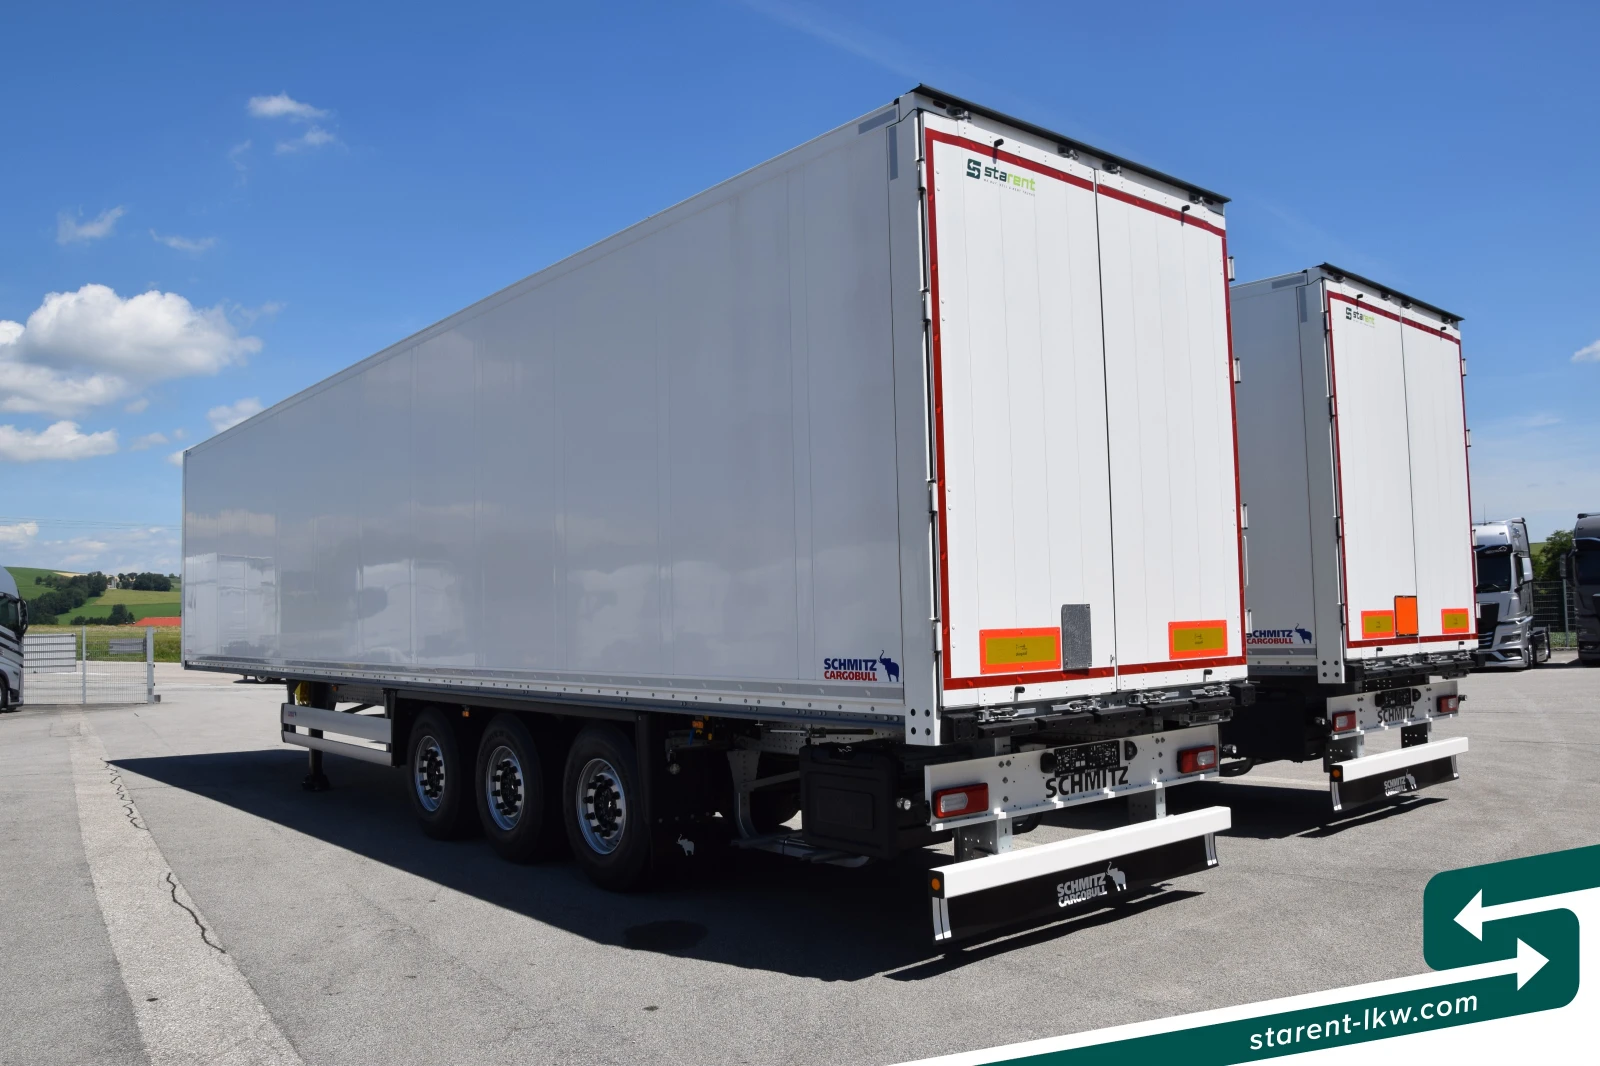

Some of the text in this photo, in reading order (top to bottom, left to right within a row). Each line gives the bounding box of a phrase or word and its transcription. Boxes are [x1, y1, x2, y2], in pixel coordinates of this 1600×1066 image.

[983, 166, 1036, 192] starent
[1246, 629, 1293, 638] SCHMITZ
[1246, 637, 1294, 645] CARGOBULL
[823, 657, 878, 672] SCHMITZ
[823, 670, 878, 682] CARGOBULL
[1377, 705, 1415, 724] SCHMITZ
[1045, 765, 1129, 799] SCHMITZ
[1383, 775, 1406, 790] SCHMITZ
[1056, 872, 1107, 898] SCHMITZ
[1058, 885, 1108, 908] CARGOBULL
